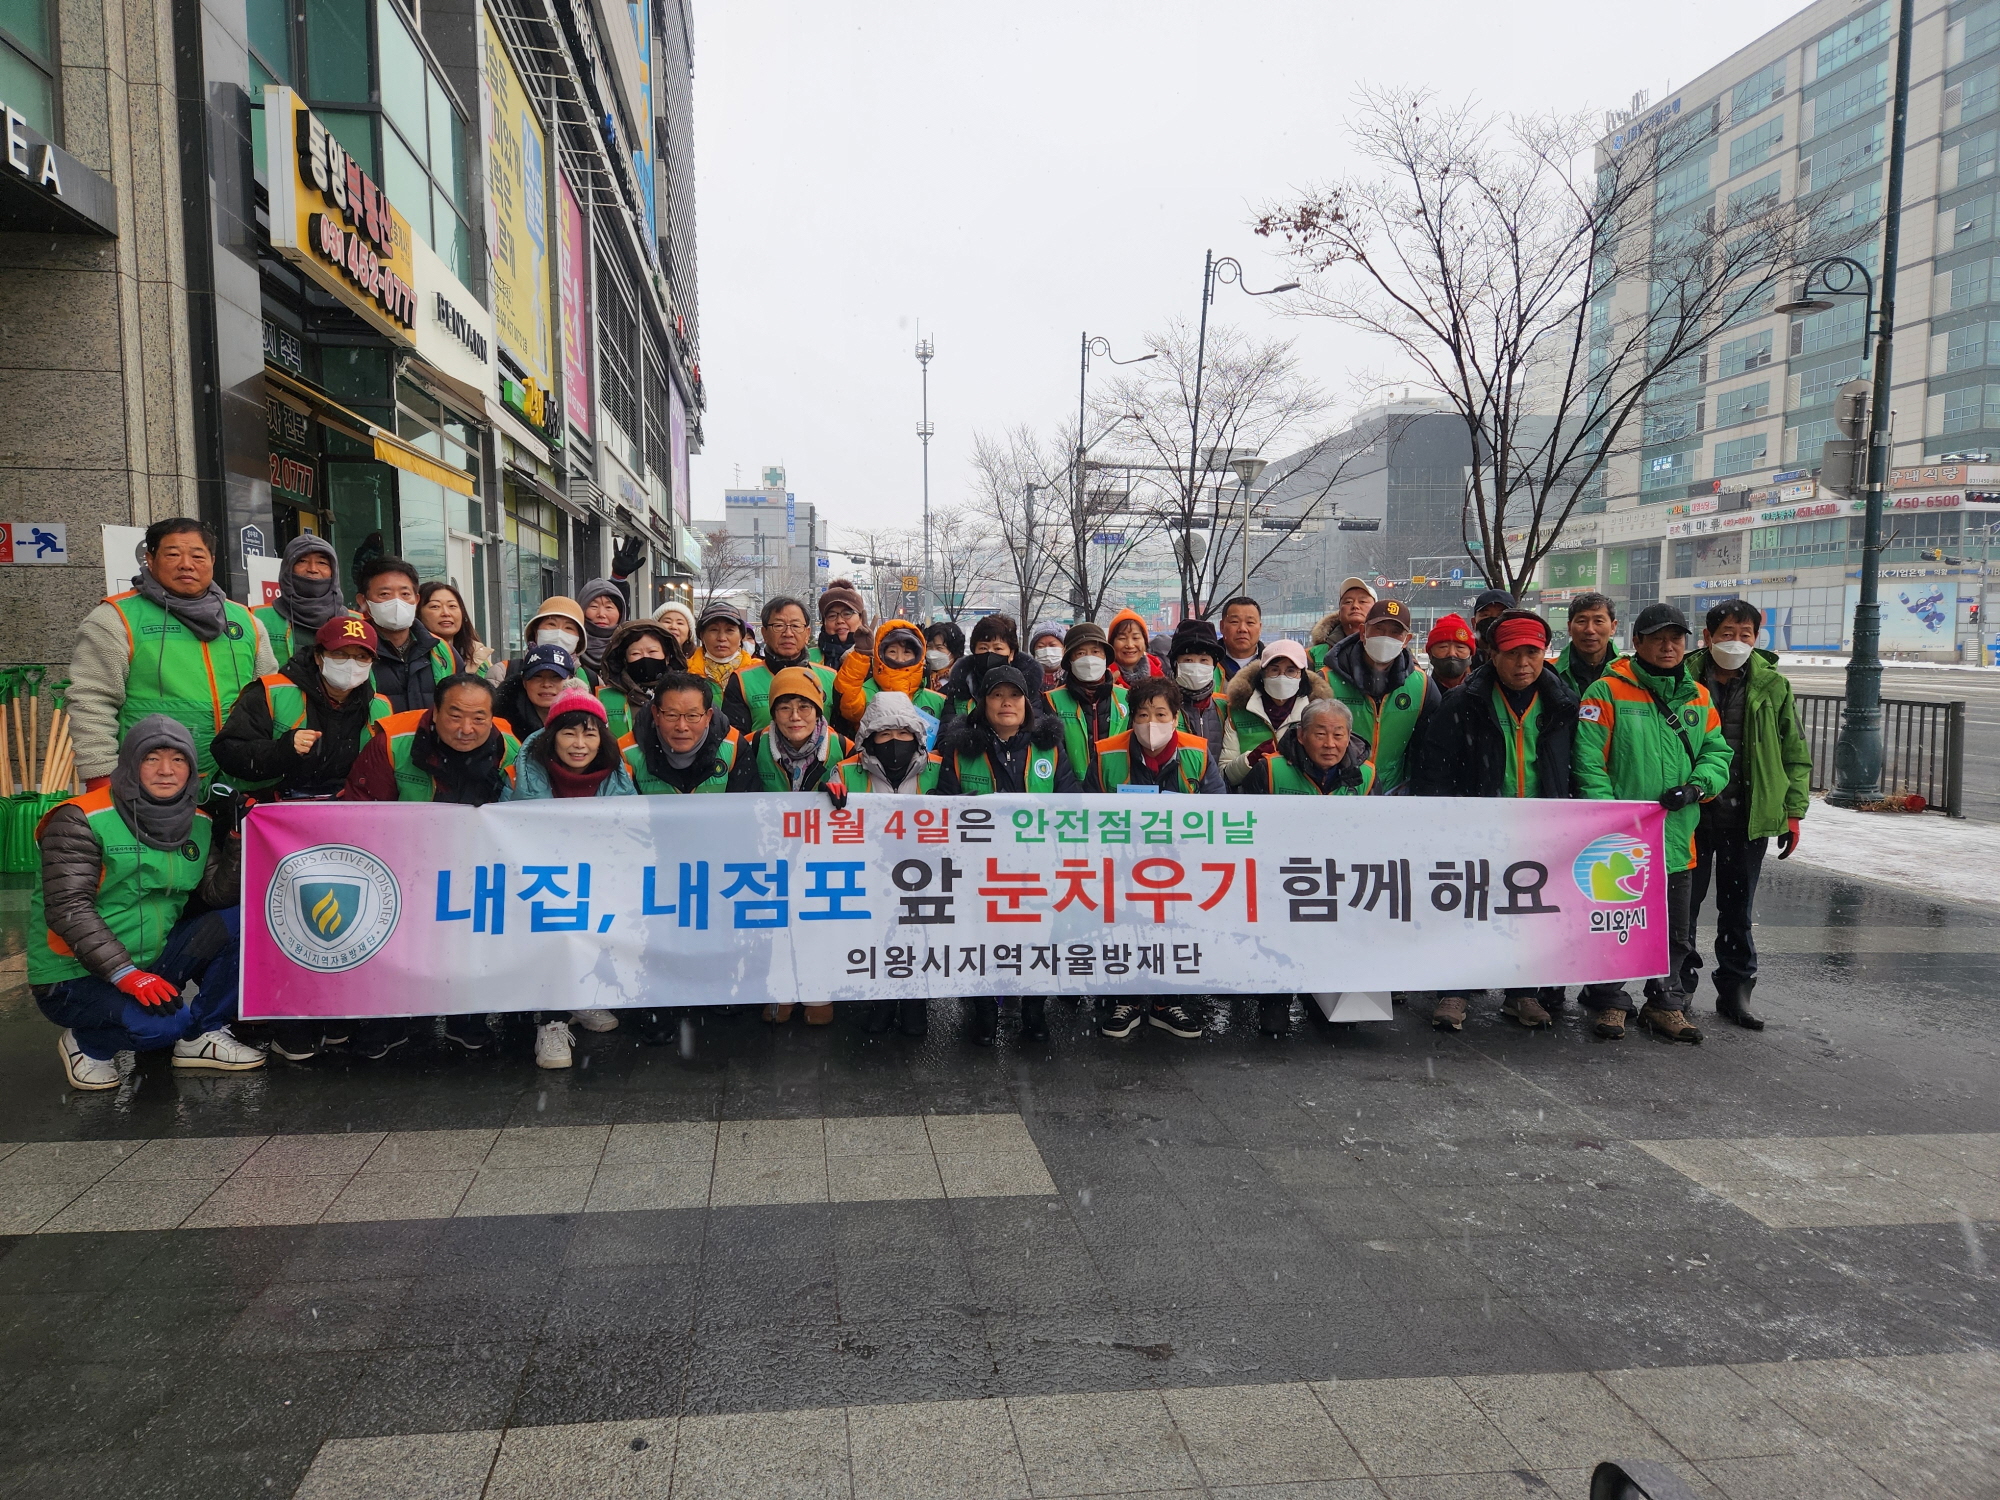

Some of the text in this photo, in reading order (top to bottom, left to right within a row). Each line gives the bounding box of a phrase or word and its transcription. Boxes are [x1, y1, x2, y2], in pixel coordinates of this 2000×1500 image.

[0, 101, 62, 195] EA
[493, 100, 521, 188] 미있게
[499, 215, 516, 280] 르게
[348, 231, 418, 330] 452-0777
[270, 452, 314, 498] 2 0777
[1894, 494, 1960, 509] 450-6500
[1708, 580, 1720, 589] IBK
[1891, 568, 1926, 578] 기업은행
[783, 809, 1258, 845] 매월 4일은 안전점검의날
[273, 851, 393, 926] CITIZEN CORPS ACTIVE IN DISASTER
[435, 857, 1562, 936] 내집, 내점포 앞 눈치우기 함께 해요
[1590, 906, 1647, 945] 의왕시
[846, 942, 1203, 980] 의왕시지역자율방재단
